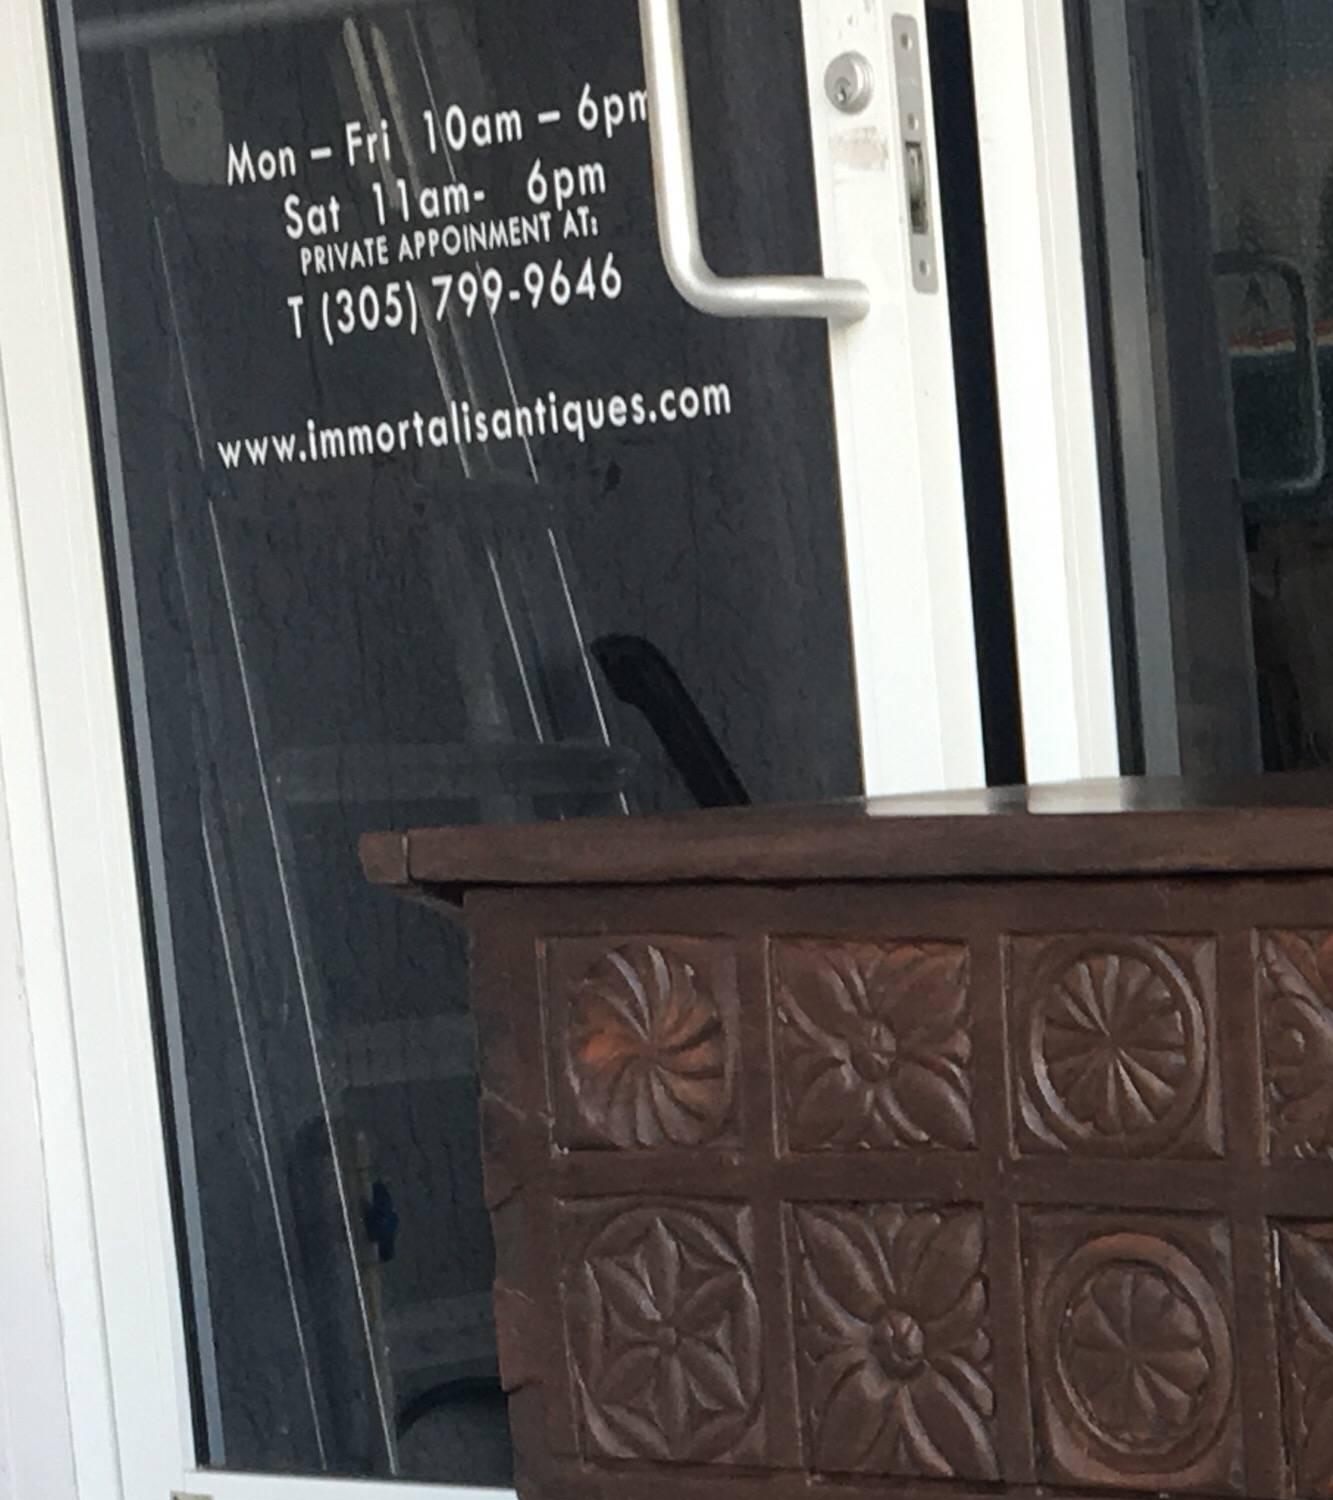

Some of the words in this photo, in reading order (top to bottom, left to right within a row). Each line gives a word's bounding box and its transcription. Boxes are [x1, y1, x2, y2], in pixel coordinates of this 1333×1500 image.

[227, 141, 297, 186] Mon
[345, 118, 391, 167] Fri
[423, 105, 523, 154] 10am
[284, 194, 340, 240] Sat
[527, 158, 606, 205] 6pm
[300, 235, 389, 277] PRIVATE
[398, 211, 553, 262] APPOINMENT
[563, 205, 599, 239] AT:
[287, 295, 304, 339] T
[322, 280, 418, 346] (305)
[431, 252, 622, 323] 799-9646
[217, 383, 731, 469] www.immortalisantiques.com
